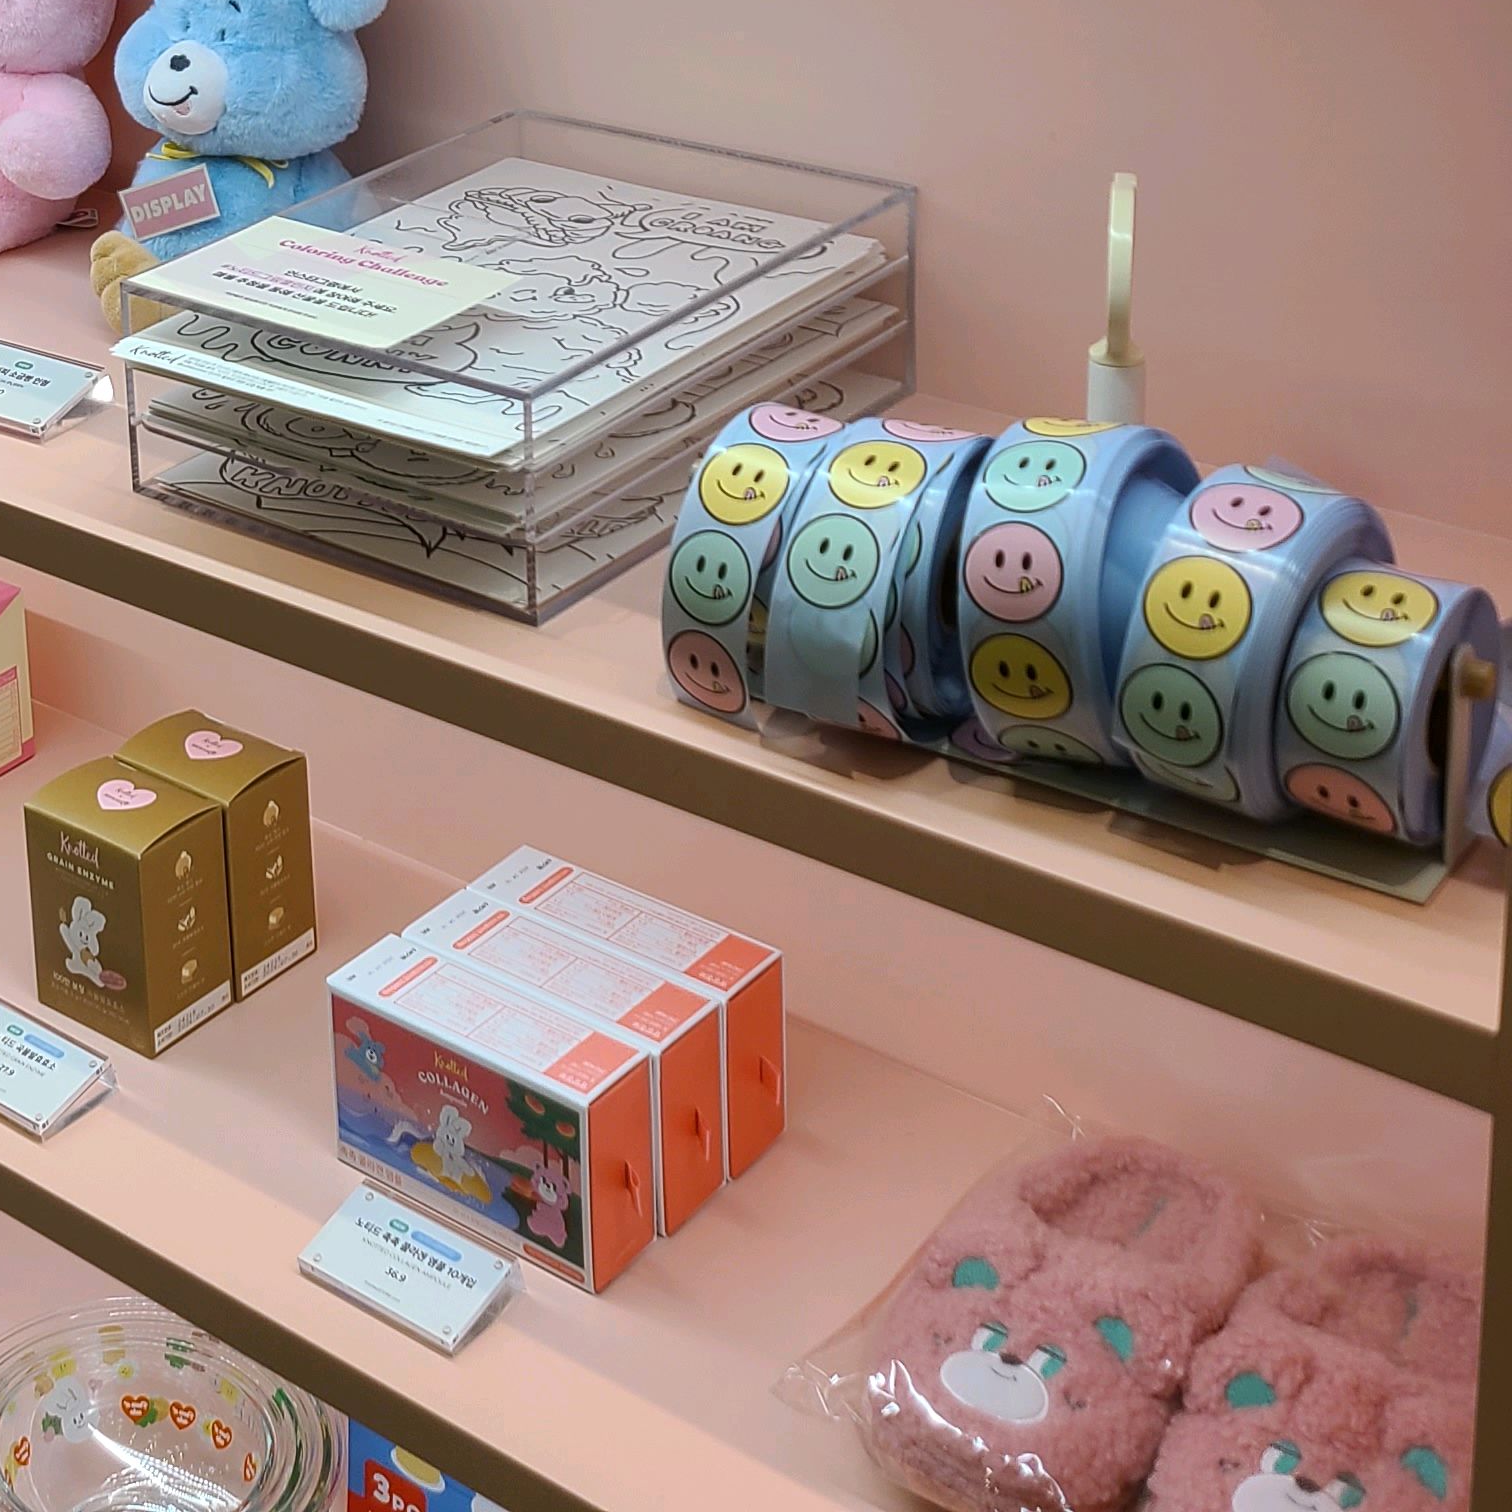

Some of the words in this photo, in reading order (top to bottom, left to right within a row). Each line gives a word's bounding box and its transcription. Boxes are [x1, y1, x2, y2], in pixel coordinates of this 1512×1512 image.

[130, 183, 205, 223] DISPLAY
[279, 239, 354, 265] Coloring
[357, 259, 449, 288] Challenge
[128, 343, 184, 365] Knotted
[232, 465, 350, 501] KNOT
[59, 831, 100, 869] Knotted
[47, 852, 75, 872] GRAIN
[76, 866, 115, 890] ENZYME
[433, 1051, 469, 1081] Knotted
[417, 1071, 489, 1116] COLLAGEN
[354, 1217, 382, 1237] 노티드
